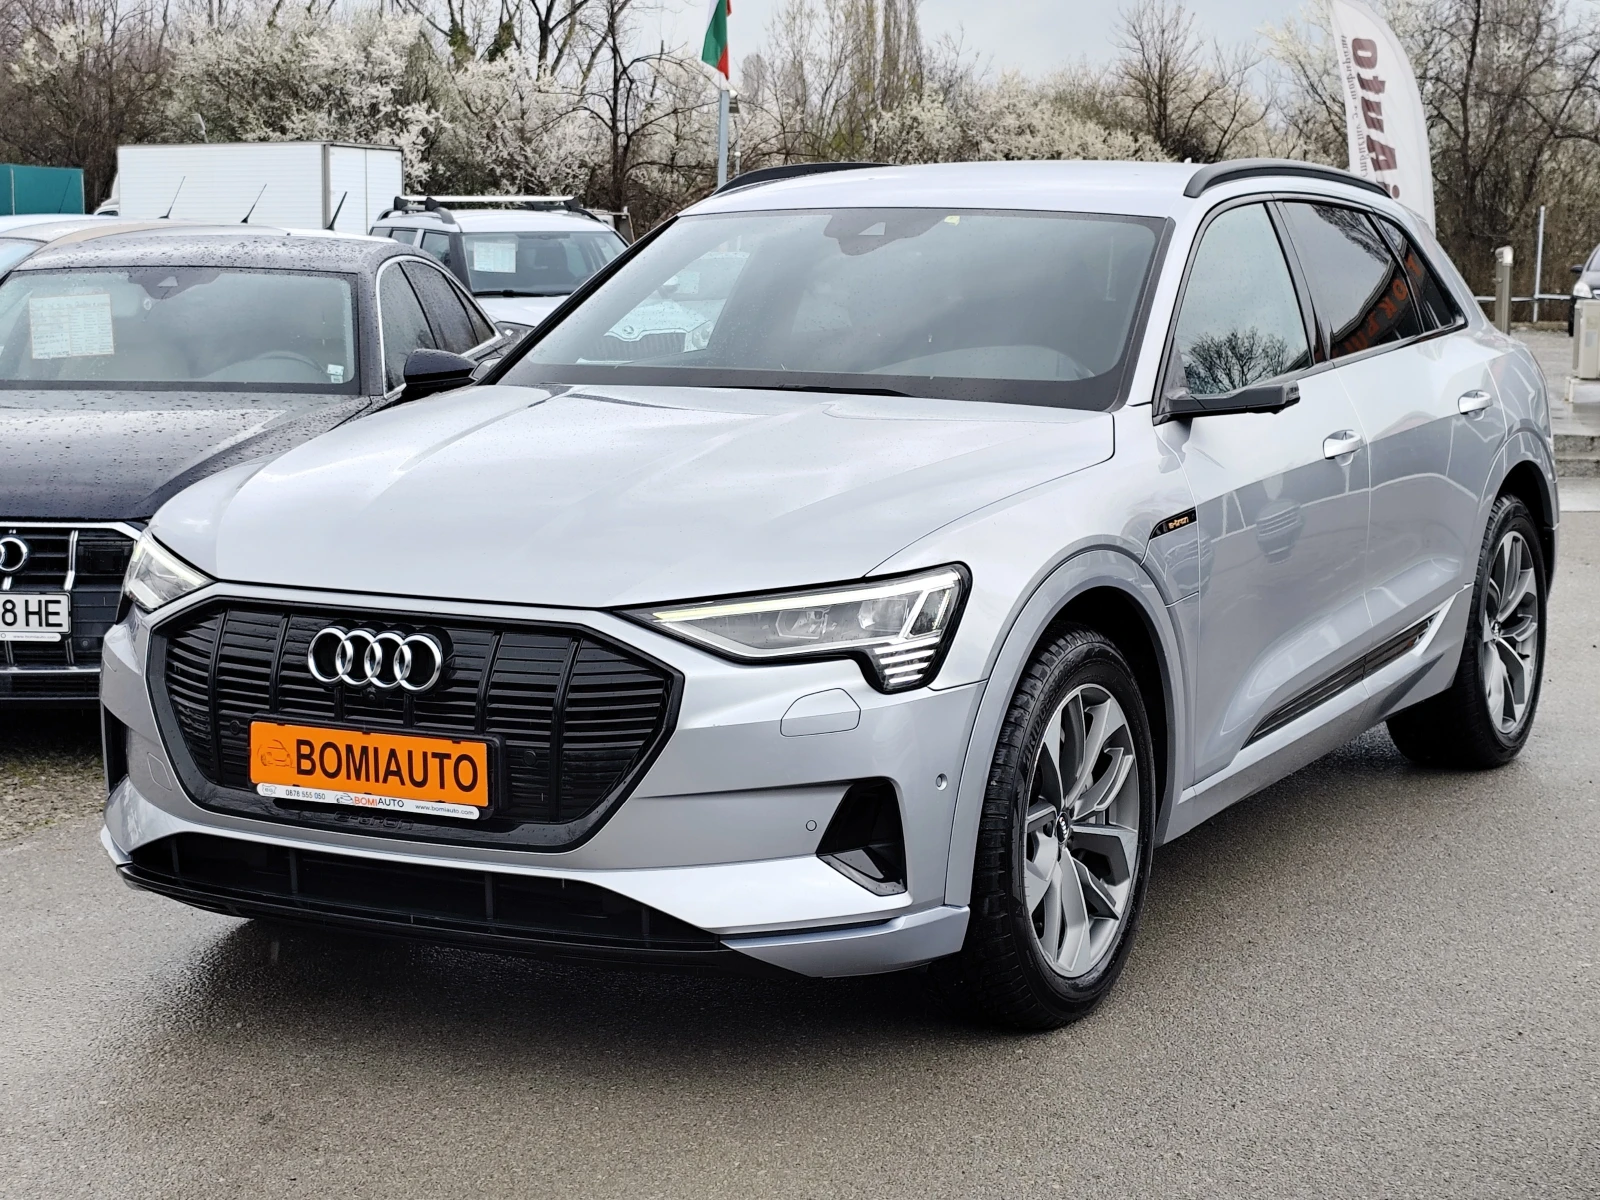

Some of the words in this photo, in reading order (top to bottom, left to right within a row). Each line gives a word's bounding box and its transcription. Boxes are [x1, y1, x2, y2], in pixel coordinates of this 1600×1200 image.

[1168, 516, 1189, 529] e-tron
[25, 599, 64, 627] HE
[296, 739, 479, 793] BOMIAUTO
[354, 796, 405, 808] BOMIAUTO
[415, 804, 475, 816] www.bomiauto.com
